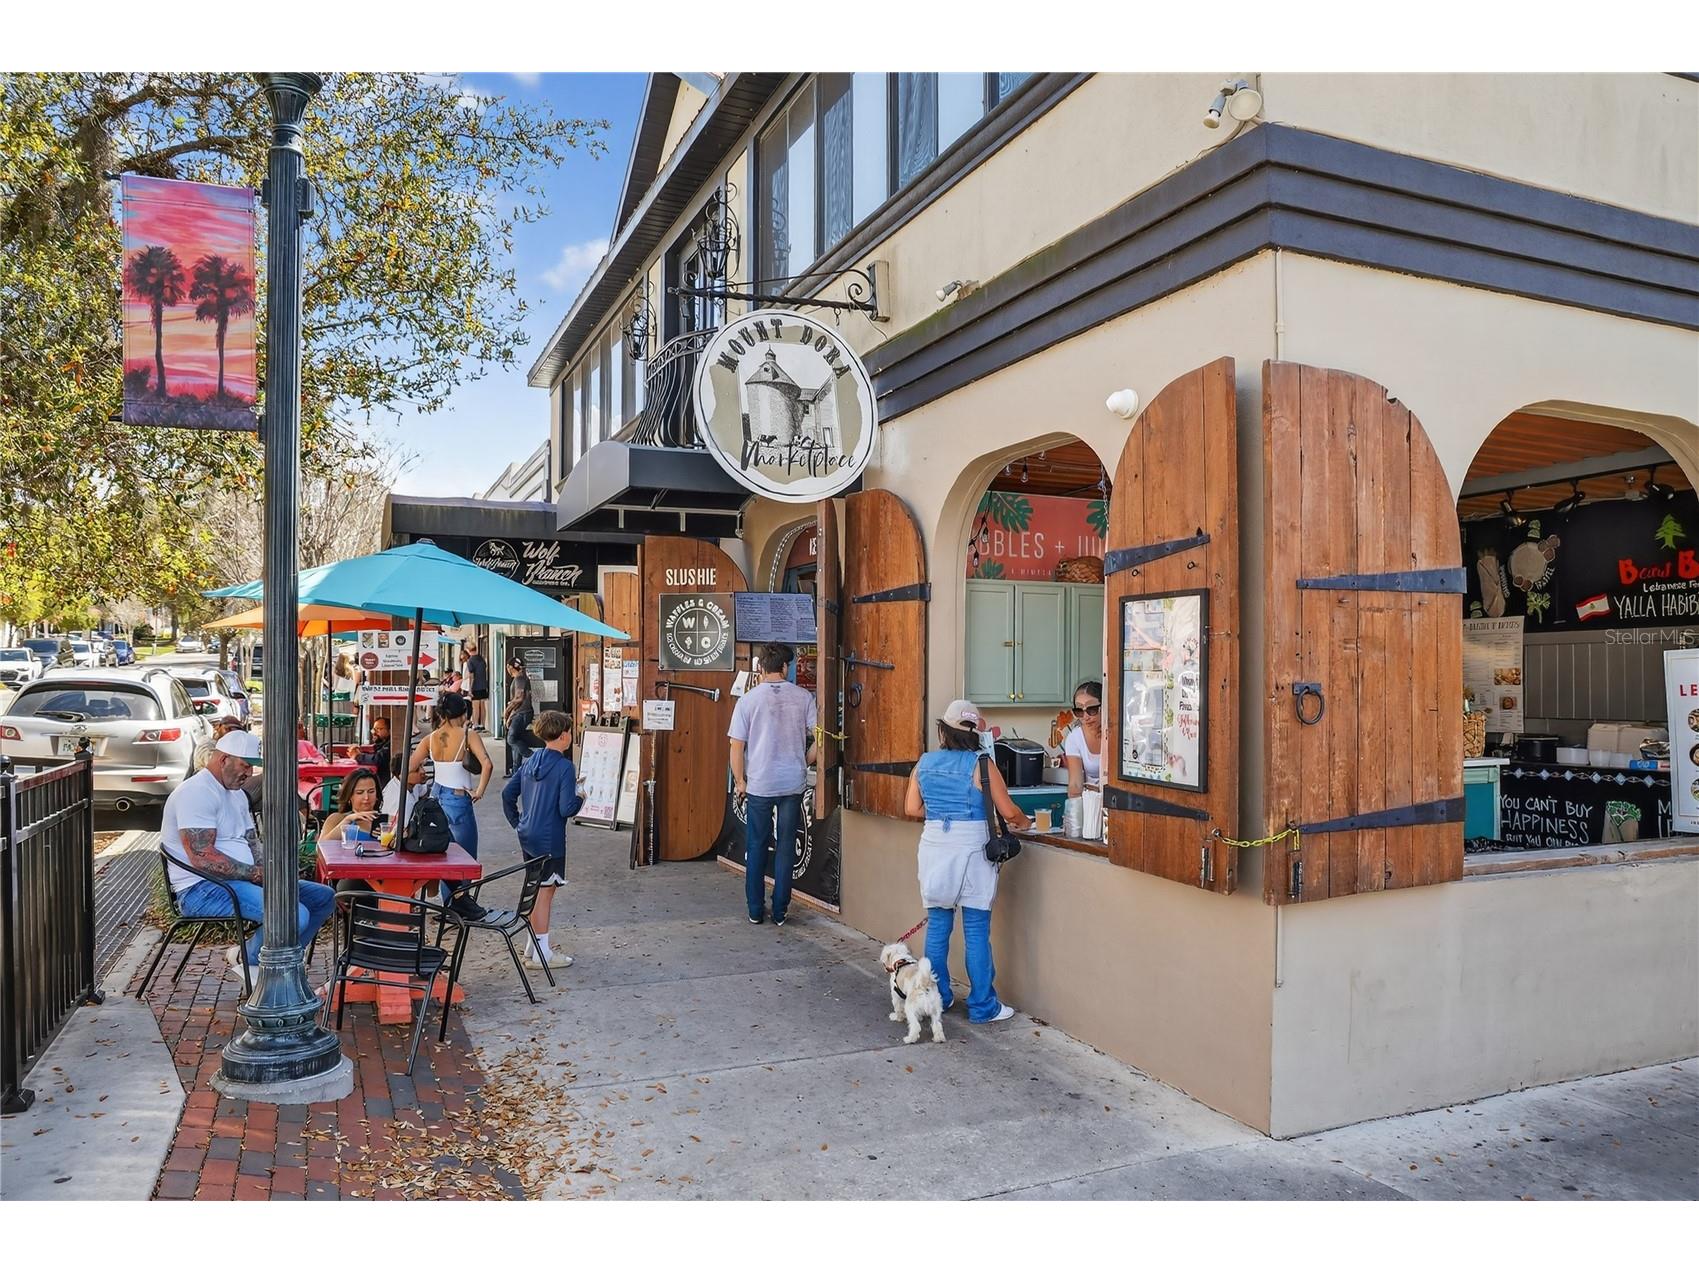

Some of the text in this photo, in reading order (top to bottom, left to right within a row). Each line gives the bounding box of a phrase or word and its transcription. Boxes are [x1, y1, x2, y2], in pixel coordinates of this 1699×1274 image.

[716, 318, 852, 380] MOUNT DORA
[740, 439, 857, 478] Marketplace
[522, 541, 560, 566] Wolf
[522, 560, 583, 588] Branch
[665, 567, 717, 587] SLUSHIE
[665, 599, 696, 629] WAFFLES
[706, 601, 730, 629] CREAM
[1613, 594, 1657, 620] YALLA
[1499, 794, 1520, 810] YOU
[1565, 801, 1593, 819] BUY
[1500, 810, 1590, 845] HAPPINESS
